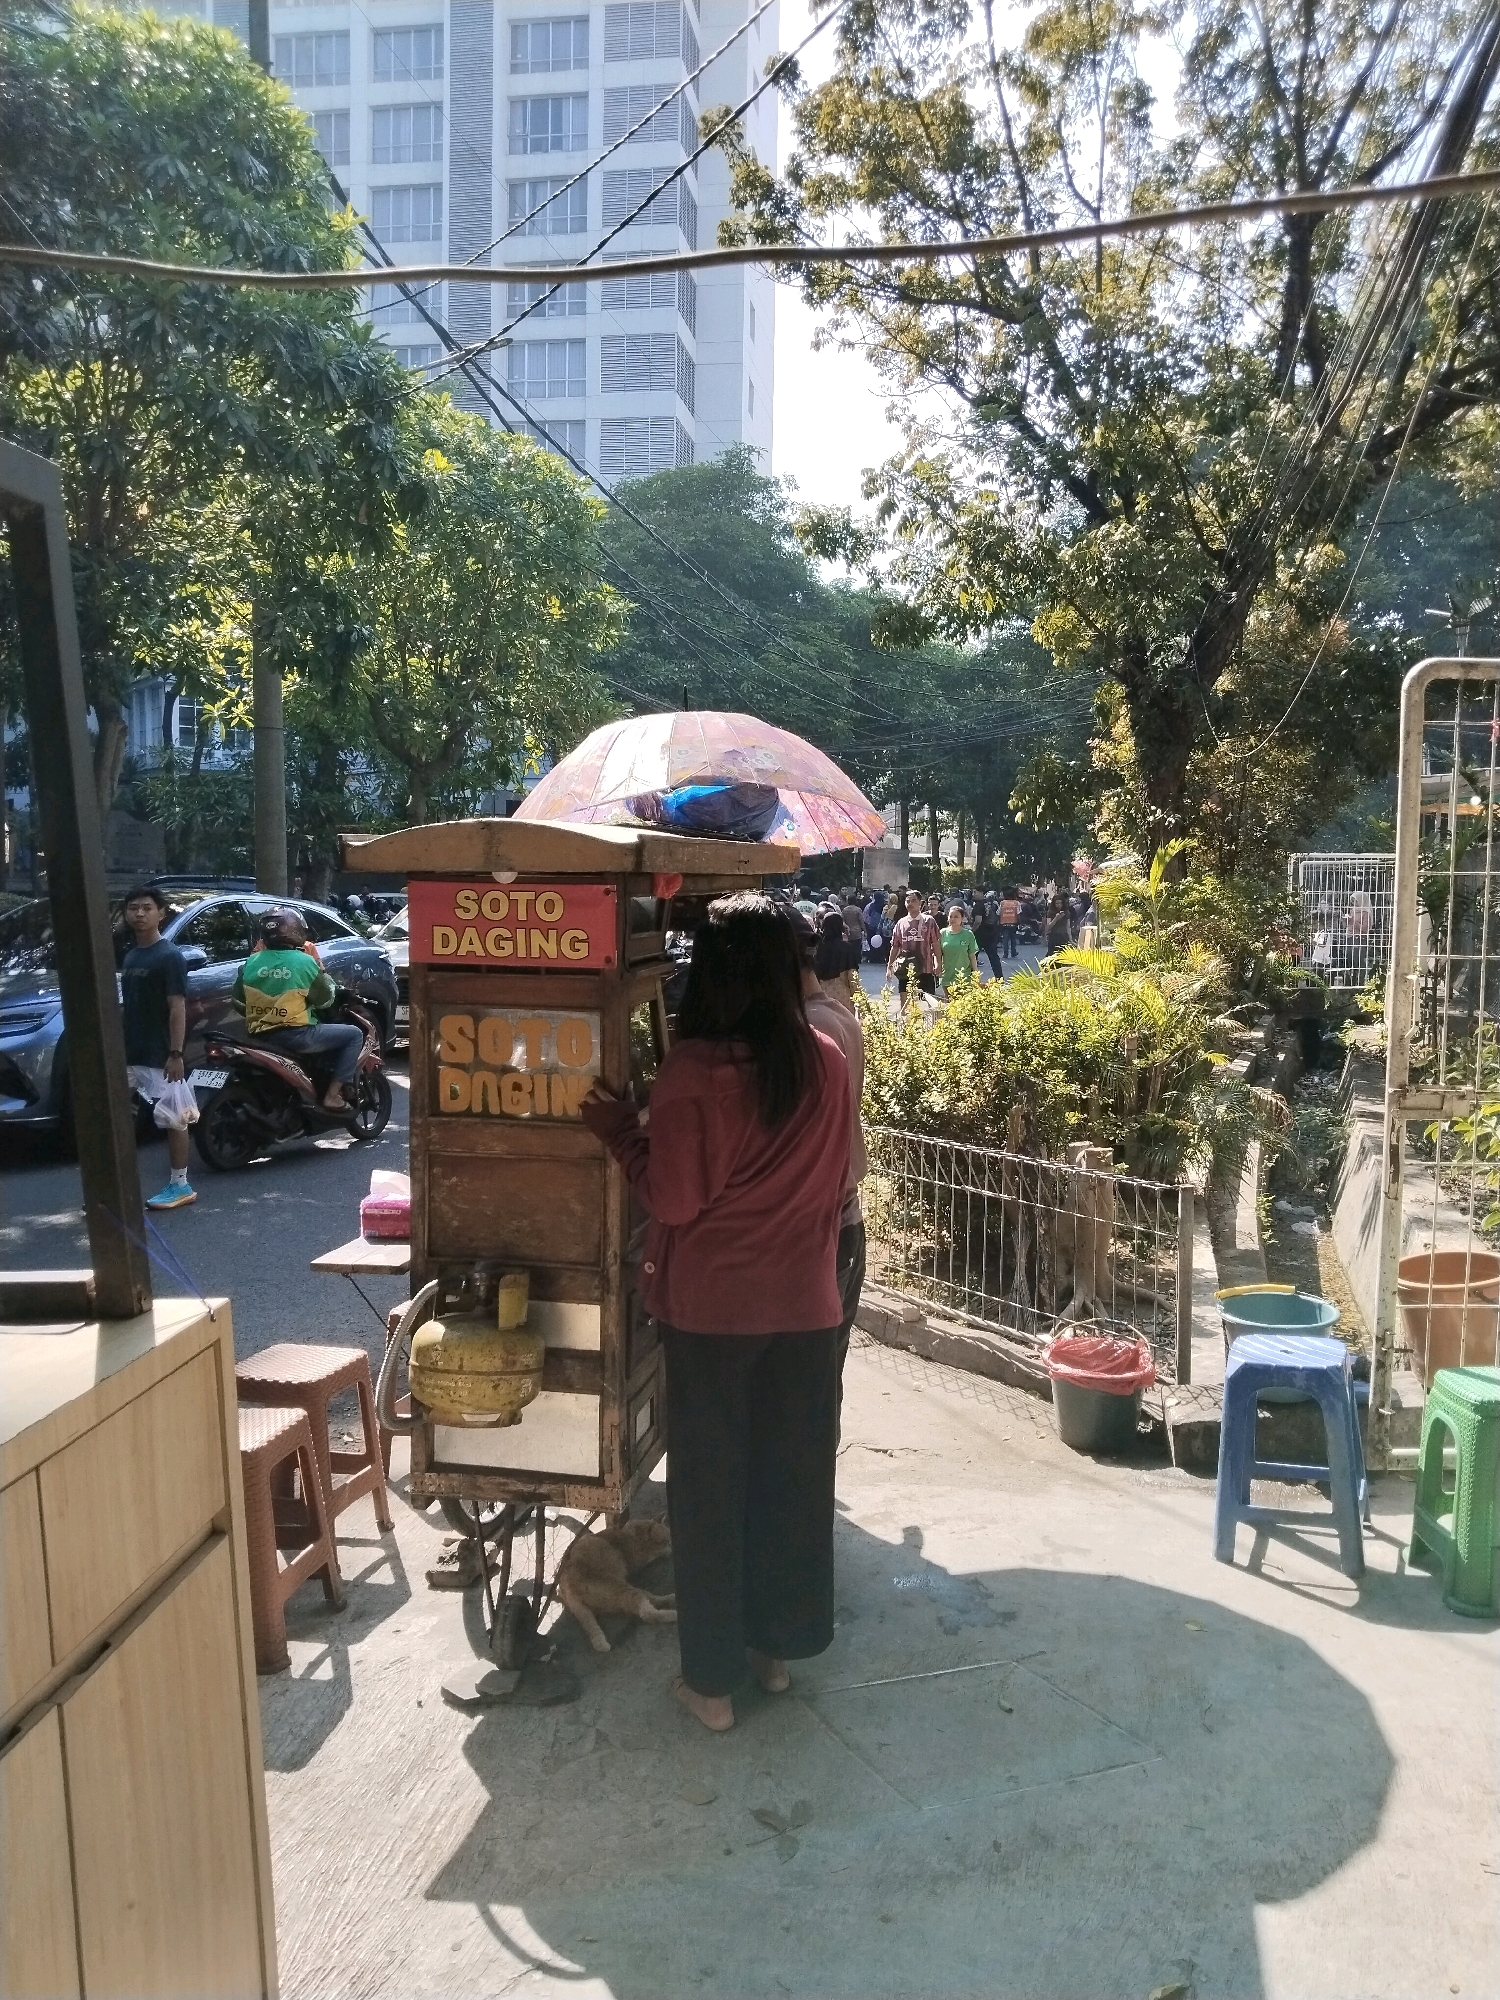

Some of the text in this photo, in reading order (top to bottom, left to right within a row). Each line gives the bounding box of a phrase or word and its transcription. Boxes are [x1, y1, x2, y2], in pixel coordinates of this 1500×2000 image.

[454, 889, 565, 922] SOTO
[432, 925, 590, 960] DAGING
[257, 966, 292, 980] Grab
[439, 1014, 593, 1068] SOTO
